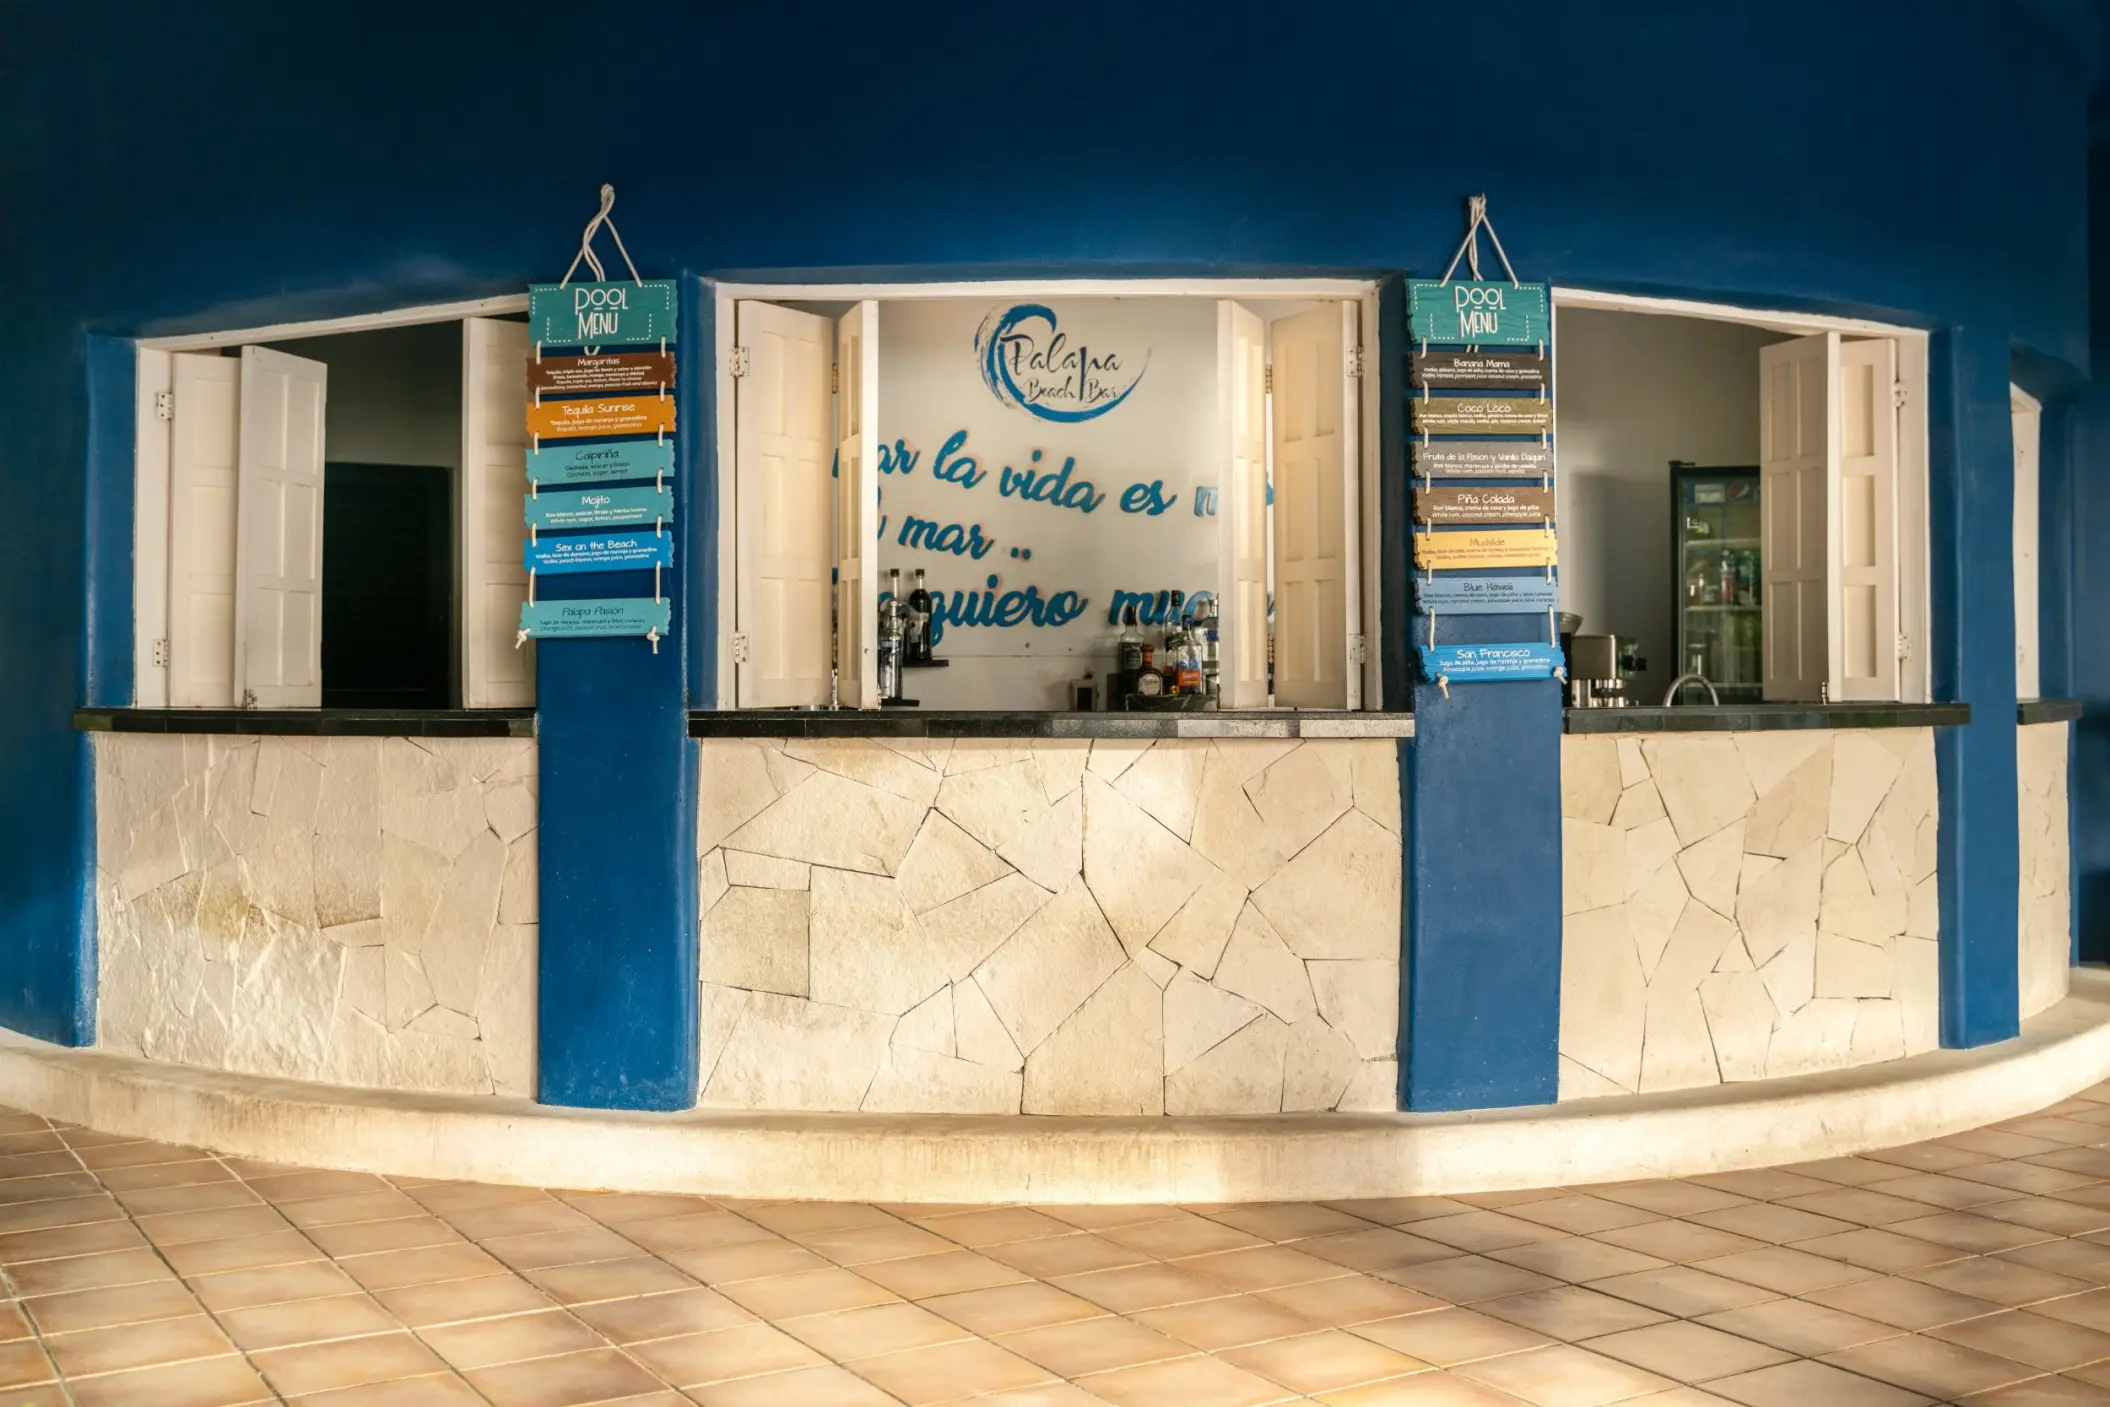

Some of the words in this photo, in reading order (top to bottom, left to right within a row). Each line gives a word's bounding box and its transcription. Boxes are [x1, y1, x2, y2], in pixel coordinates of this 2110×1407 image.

[575, 288, 628, 315] POOL
[1455, 285, 1507, 313] POOL
[578, 312, 618, 340] MENU
[1460, 310, 1498, 339] MENU
[577, 357, 620, 369] Margaritas
[1000, 332, 1123, 402] Palapa
[1453, 358, 1484, 368] Banana
[1486, 359, 1510, 368] Mama
[1024, 375, 1076, 402] Beach
[1085, 377, 1120, 403] Bar
[561, 404, 594, 419] Tequila
[597, 403, 635, 413] Sunrise
[1458, 402, 1483, 413] Coco
[1487, 403, 1511, 413] Loco
[1422, 452, 1445, 461] Fruta
[1446, 452, 1456, 461] de
[1458, 452, 1465, 461] la
[1491, 454, 1496, 464] y
[933, 429, 987, 489] la
[999, 450, 1106, 513] vida
[1120, 480, 1177, 516] es
[581, 495, 611, 509] Mojito
[1457, 493, 1479, 505] Piña
[1481, 493, 1515, 504] Colada
[898, 515, 995, 560] mar
[1469, 537, 1505, 547] Mudslide
[555, 543, 573, 552] Sex
[575, 543, 587, 551] on
[590, 541, 604, 550] the
[607, 539, 637, 549] Beach
[1463, 582, 1484, 592] Blue
[562, 607, 592, 619] Palapa
[1456, 649, 1477, 660] San
[1479, 649, 1530, 659] Francisco
